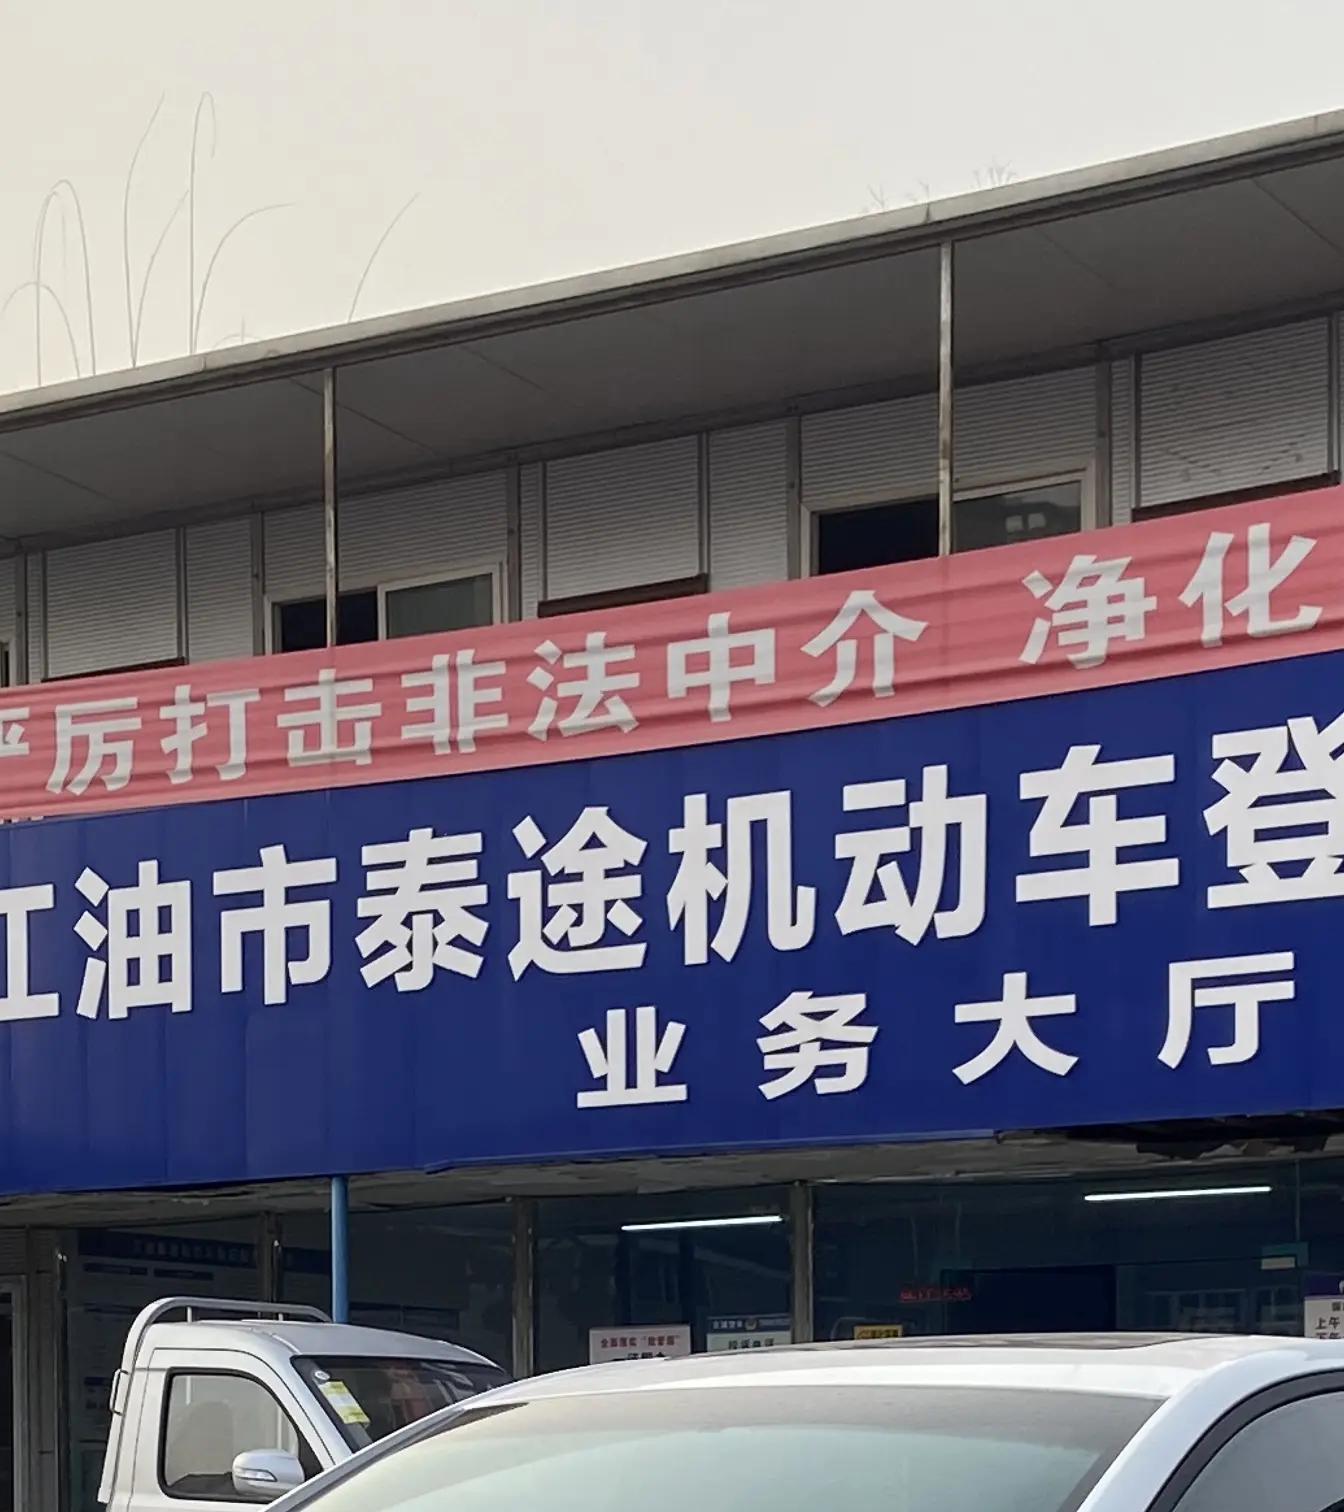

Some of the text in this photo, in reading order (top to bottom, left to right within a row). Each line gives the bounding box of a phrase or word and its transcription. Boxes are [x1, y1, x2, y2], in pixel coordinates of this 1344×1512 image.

[577, 949, 1297, 1110] 业务大厅
[1315, 1316, 1340, 1330] 上午
